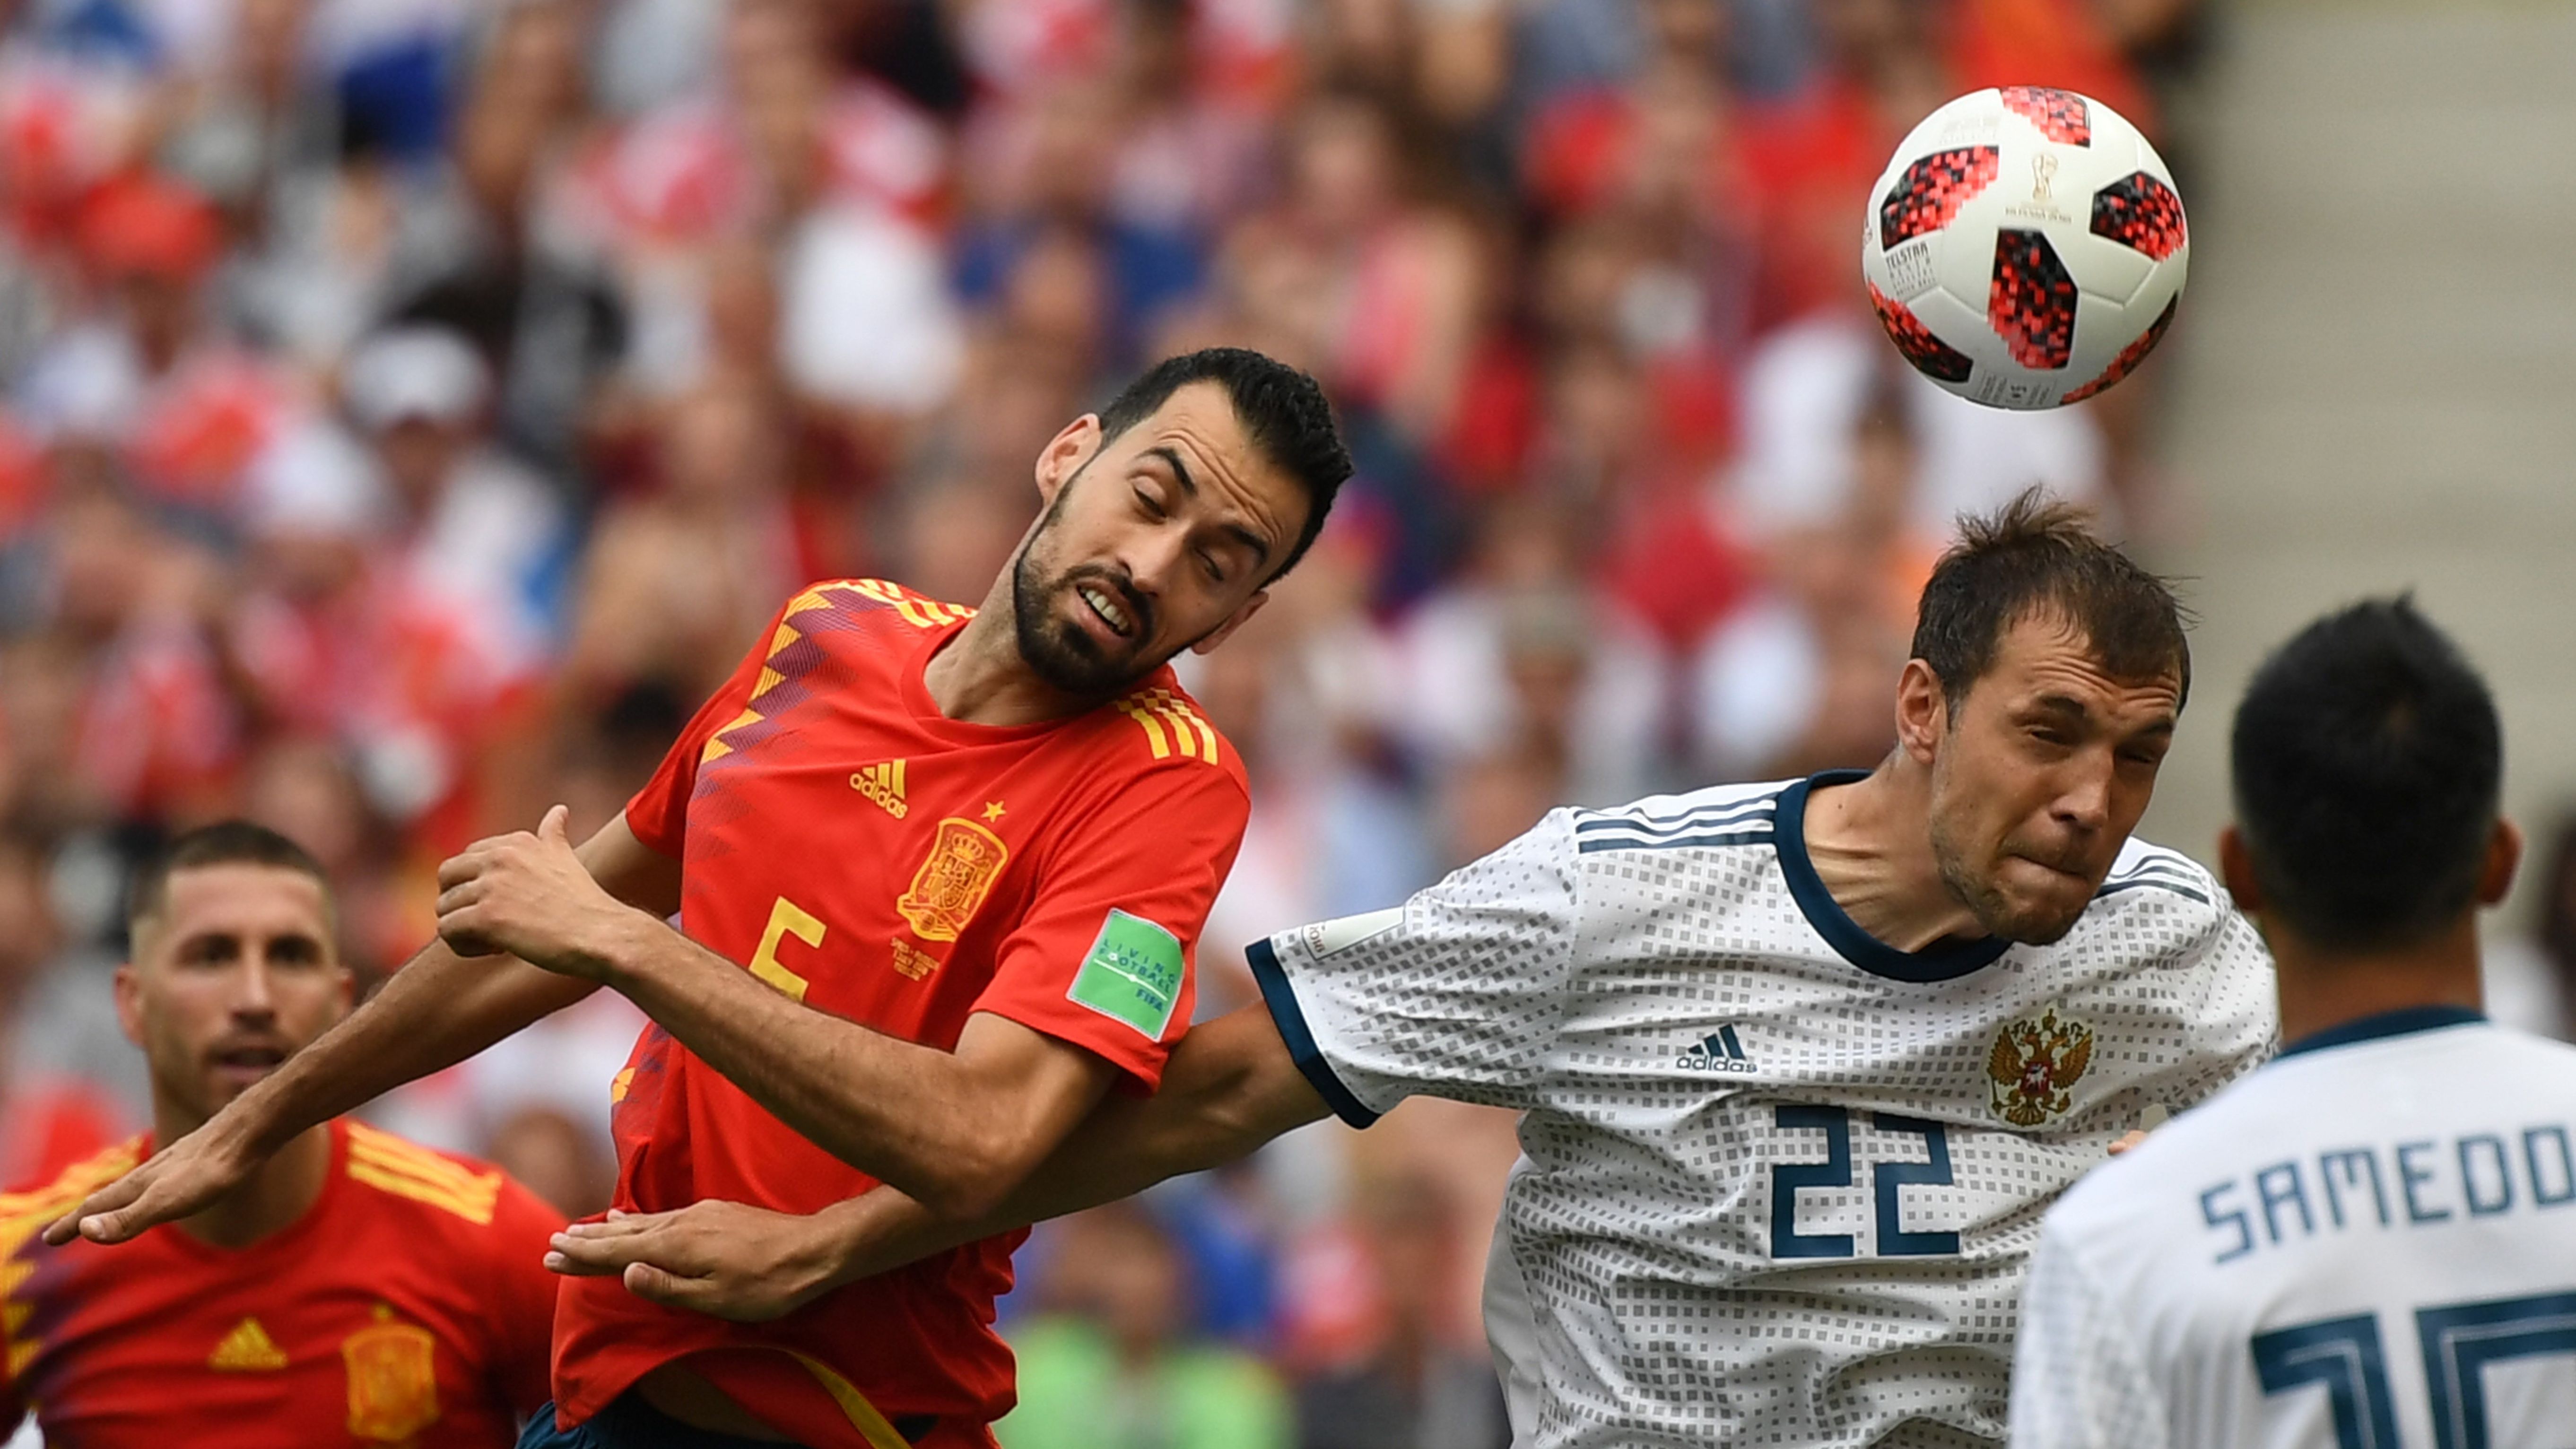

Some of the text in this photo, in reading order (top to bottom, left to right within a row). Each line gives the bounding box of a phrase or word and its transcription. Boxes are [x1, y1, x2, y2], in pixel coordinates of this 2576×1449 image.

[1885, 241, 1928, 271] TELSTAR
[850, 773, 908, 819] adidas
[748, 895, 827, 1002] 5
[1104, 939, 1175, 984] LIVING
[1136, 989, 1163, 1012] FIFA
[1677, 1055, 1758, 1073] adidas
[1771, 1105, 1960, 1258] 22
